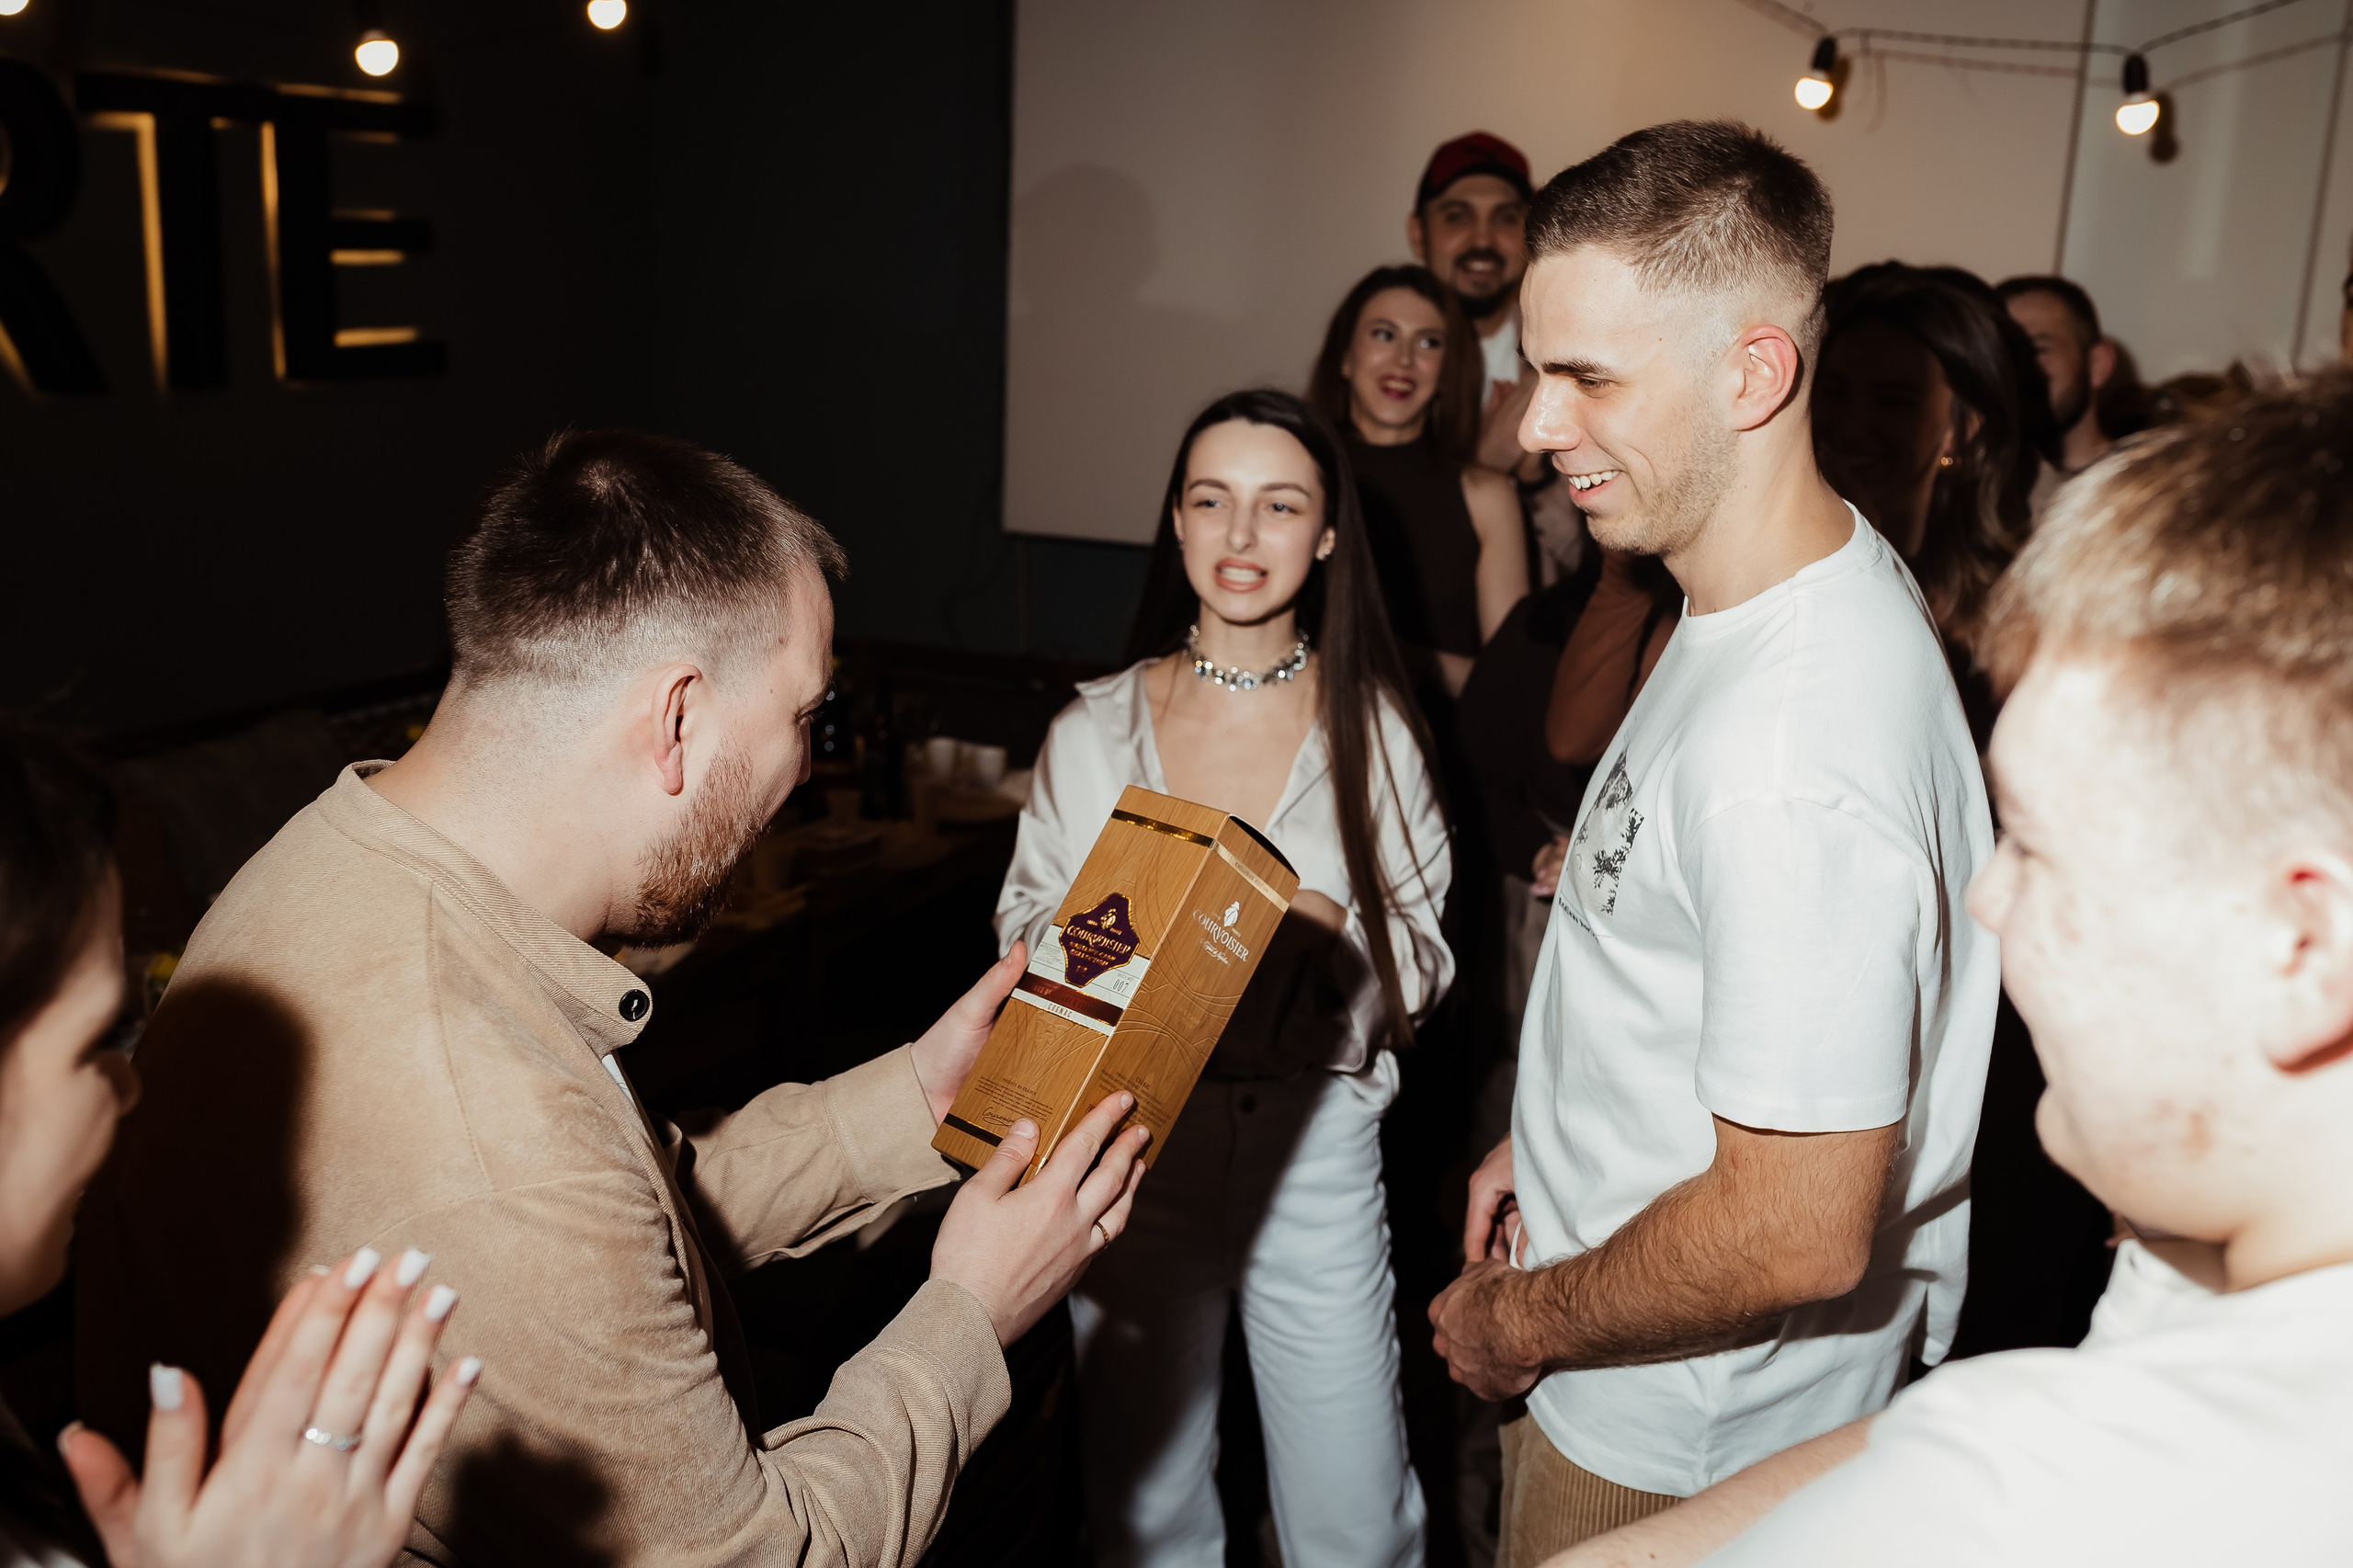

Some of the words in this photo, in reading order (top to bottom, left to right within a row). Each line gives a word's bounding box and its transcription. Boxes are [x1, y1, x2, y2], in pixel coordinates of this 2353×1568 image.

[1066, 925, 1131, 955] COURVOISIER
[1192, 908, 1250, 962] COURVOISIER
[1112, 979, 1130, 994] 007
[1047, 1004, 1073, 1018] COGNAC
